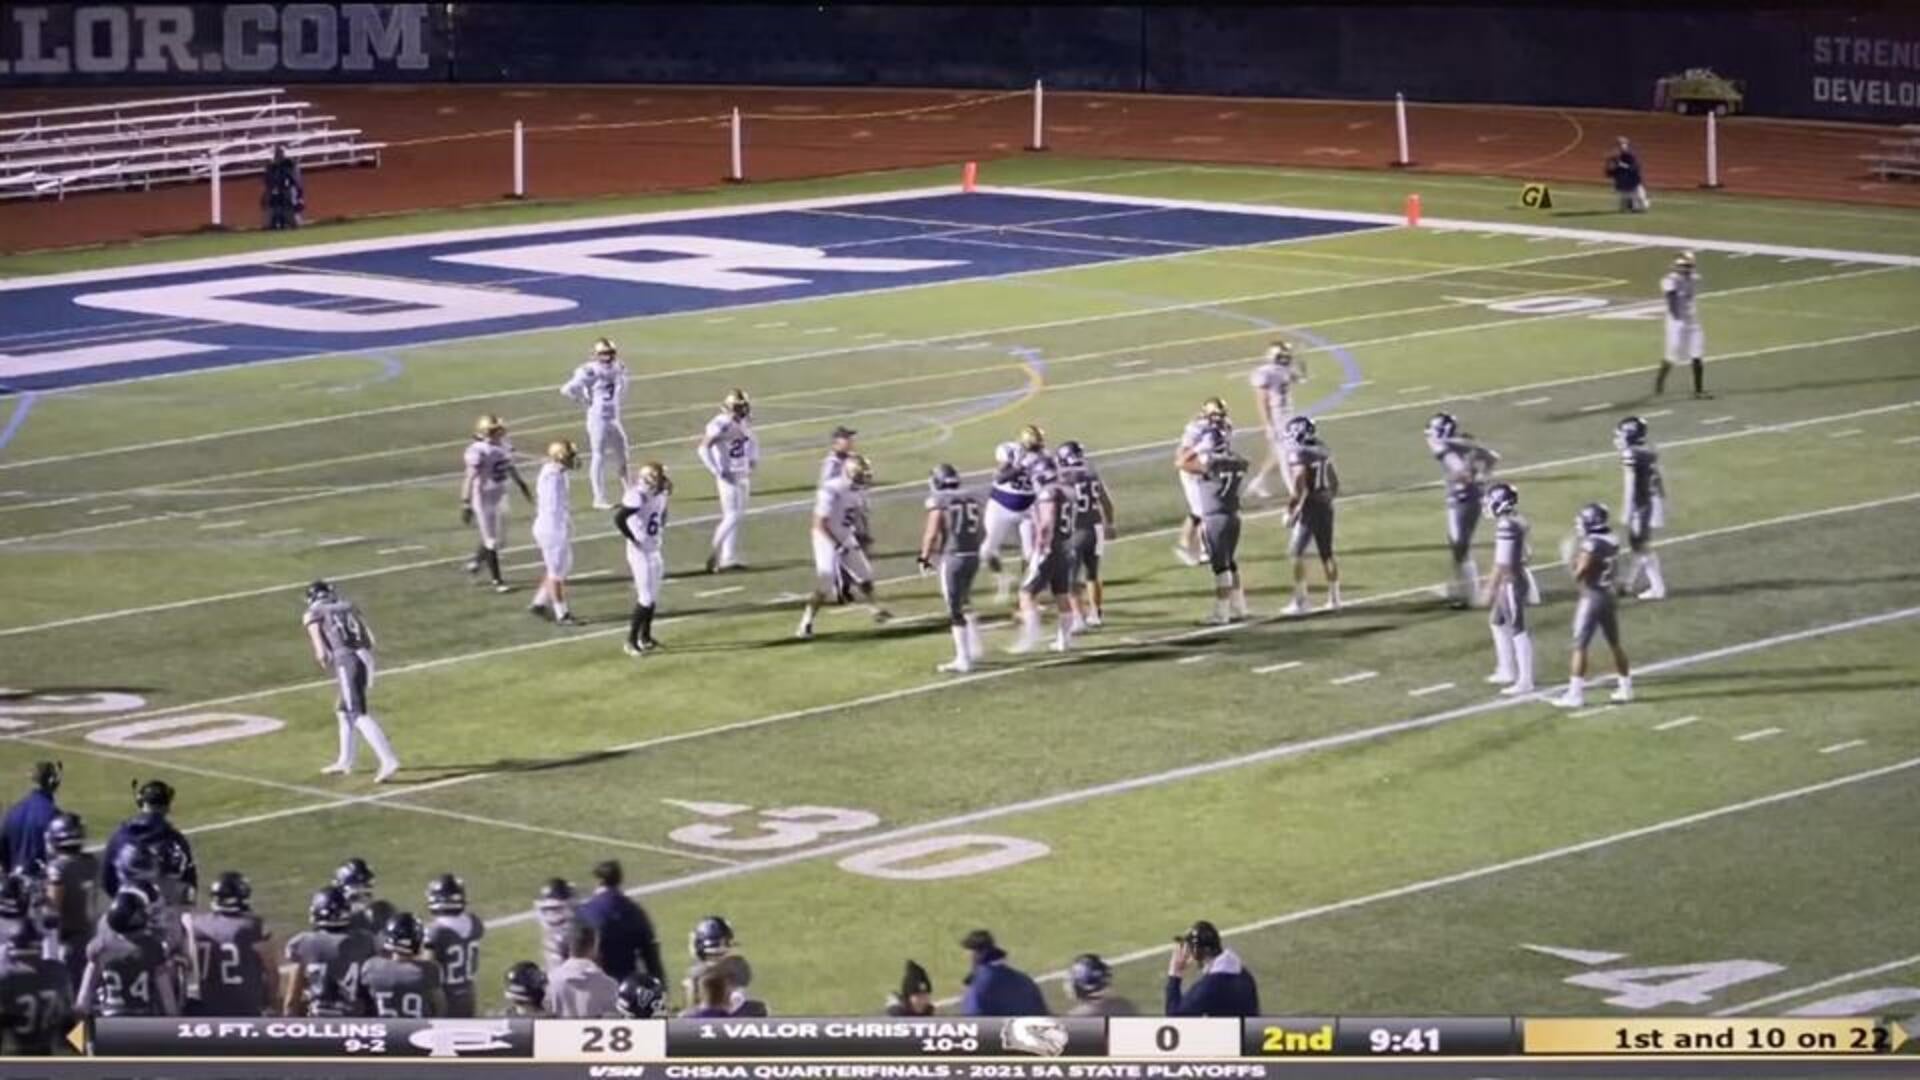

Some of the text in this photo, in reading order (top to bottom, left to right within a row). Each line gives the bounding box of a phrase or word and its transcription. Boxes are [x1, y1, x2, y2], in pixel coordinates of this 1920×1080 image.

[0, 3, 430, 74] LOR.COM
[950, 502, 980, 534] 75
[668, 805, 1051, 880] 30
[447, 941, 481, 984] 20
[101, 970, 149, 1006] 24
